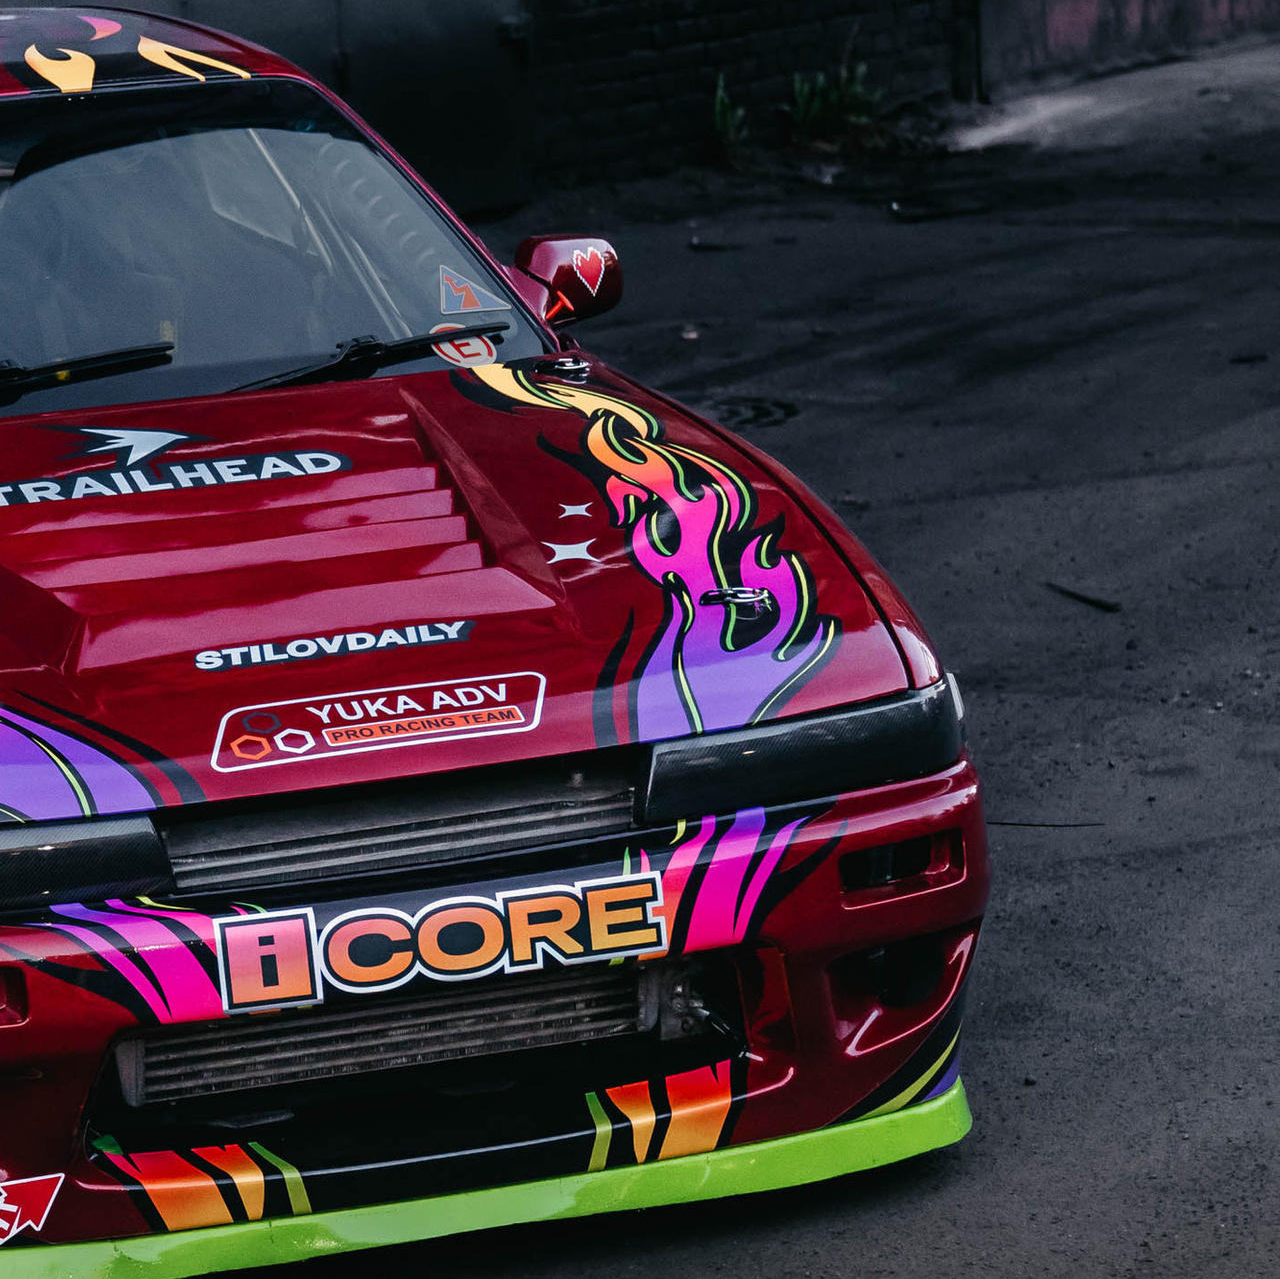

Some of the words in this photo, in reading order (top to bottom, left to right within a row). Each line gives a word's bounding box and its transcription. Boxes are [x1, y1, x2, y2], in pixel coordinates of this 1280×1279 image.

[195, 621, 466, 670] STILOVDAILY
[306, 694, 422, 724] YUKA
[431, 683, 507, 710] ADV
[331, 727, 375, 742] PRO
[379, 716, 456, 735] RACING
[460, 709, 516, 725] TEAM
